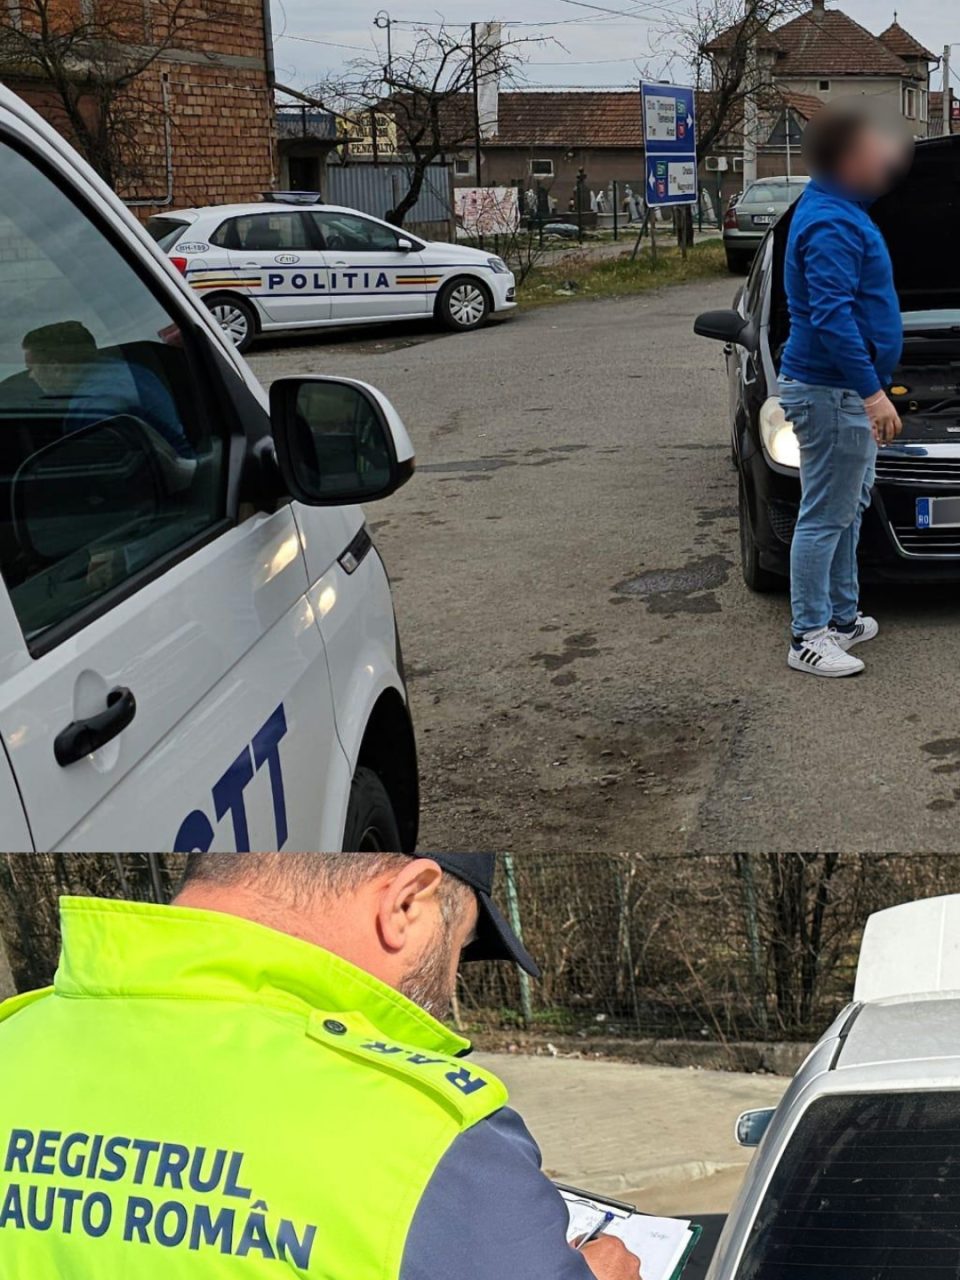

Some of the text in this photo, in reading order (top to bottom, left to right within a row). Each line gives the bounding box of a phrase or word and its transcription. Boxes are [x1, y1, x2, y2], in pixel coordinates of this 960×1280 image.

[268, 273, 390, 290] POLITIA
[918, 515, 929, 525] RO
[4, 1128, 252, 1199] REGISTRUL
[0, 1183, 318, 1271] AUTO ROMÂN
